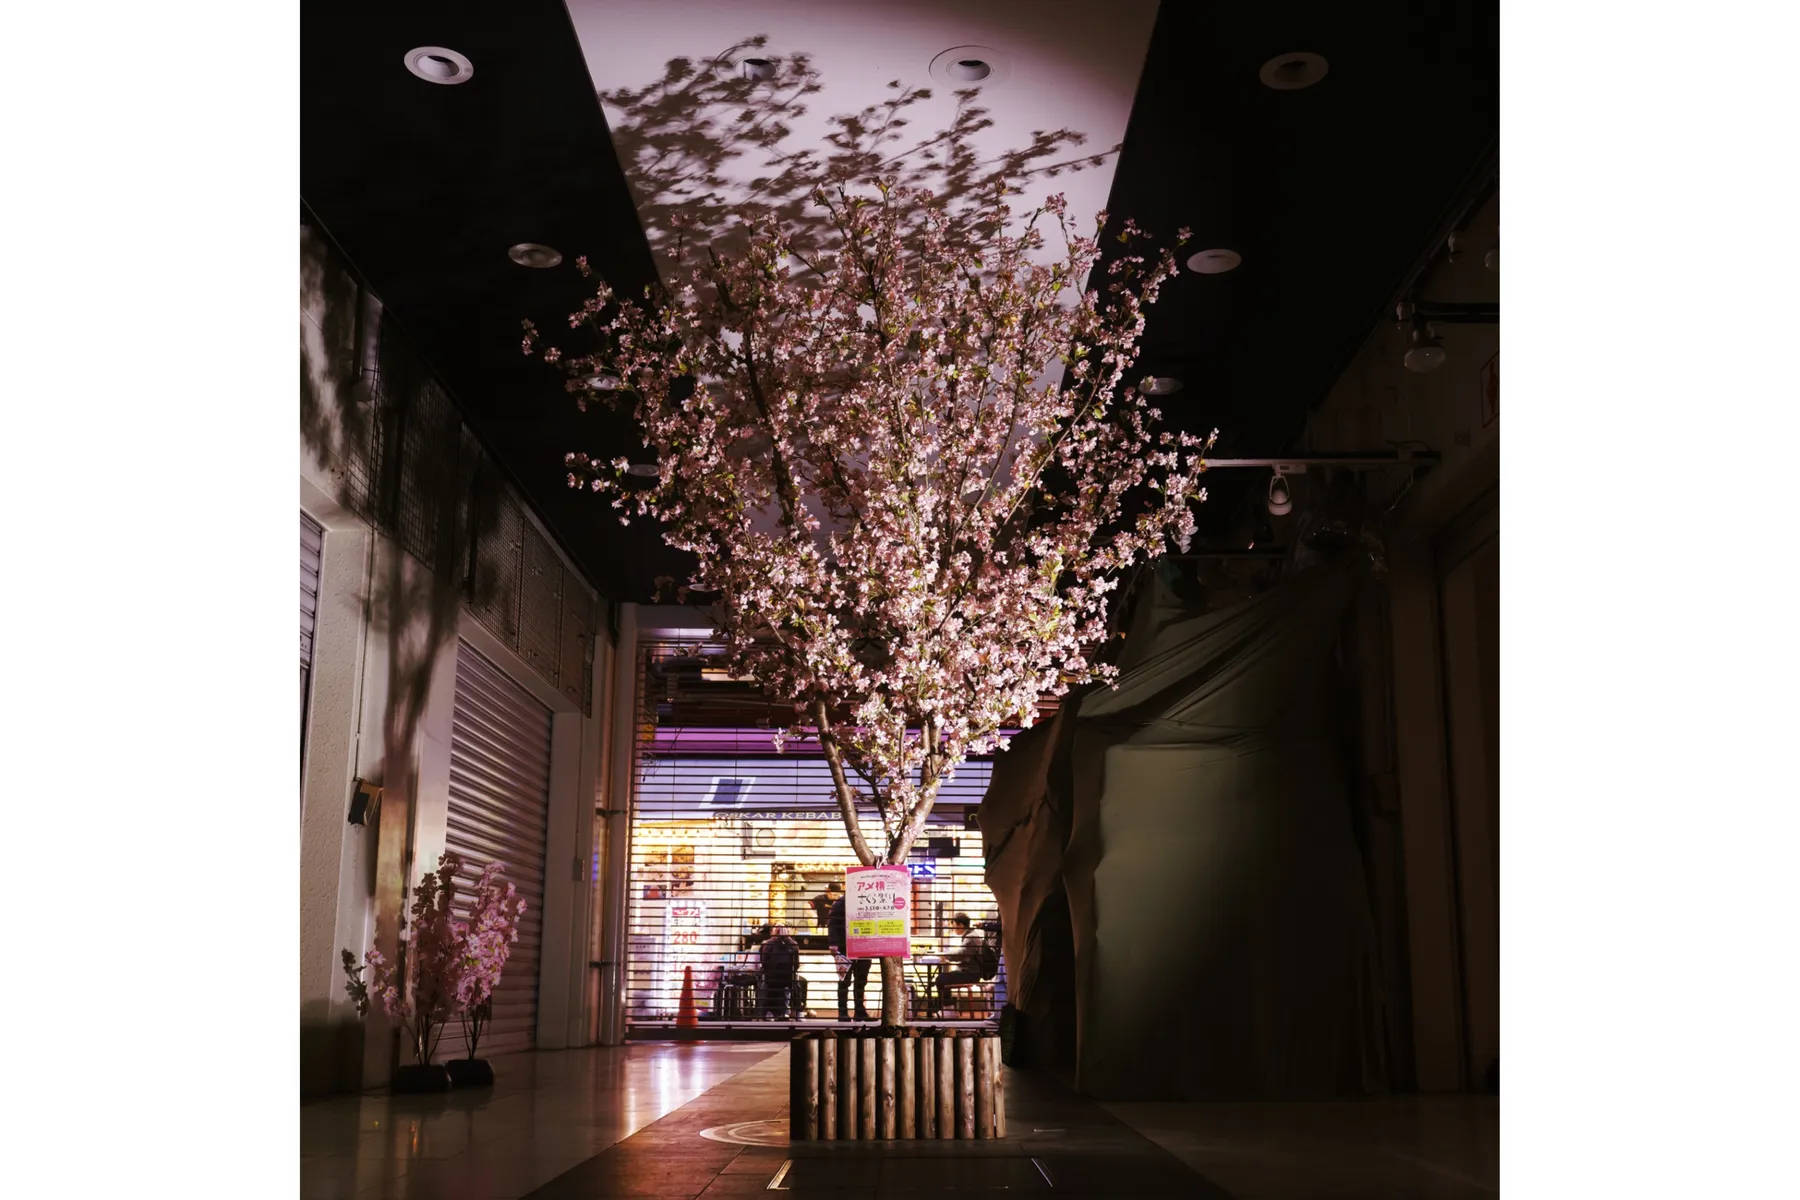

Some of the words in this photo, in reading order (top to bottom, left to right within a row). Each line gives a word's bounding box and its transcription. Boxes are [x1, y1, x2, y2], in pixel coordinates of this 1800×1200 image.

[715, 811, 777, 819] OSKAR
[781, 811, 842, 819] KEBAB
[856, 880, 885, 891] アメ横
[673, 930, 698, 945] 280
